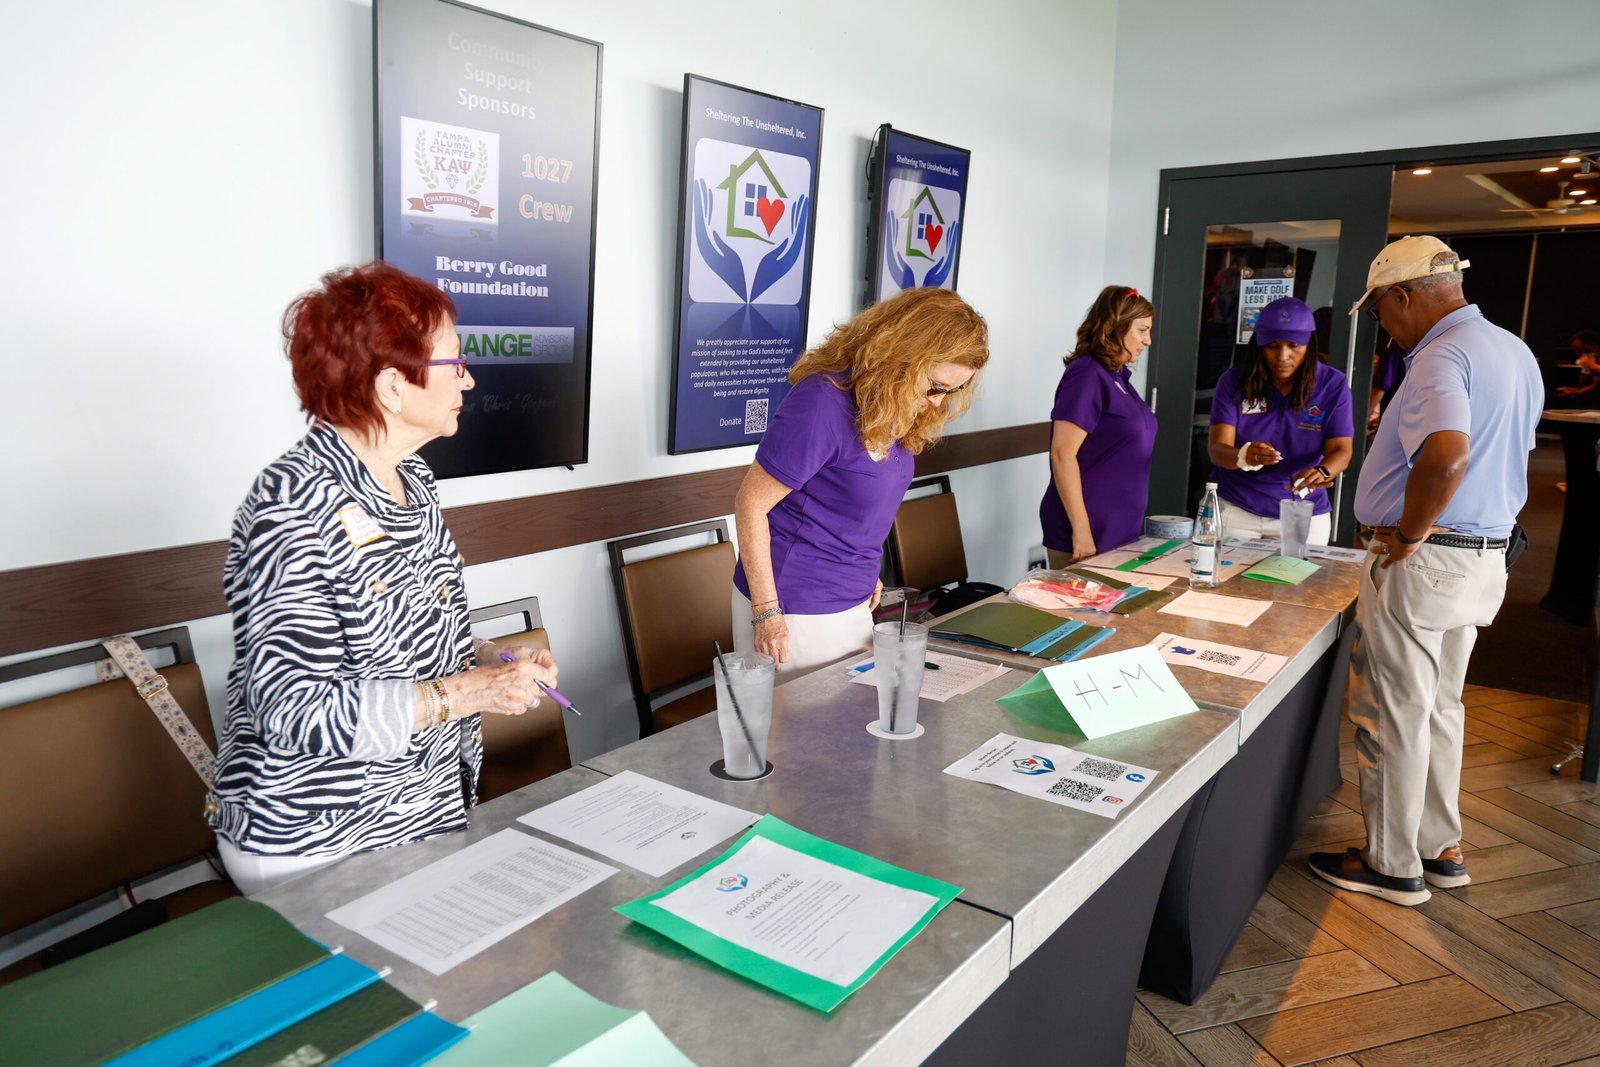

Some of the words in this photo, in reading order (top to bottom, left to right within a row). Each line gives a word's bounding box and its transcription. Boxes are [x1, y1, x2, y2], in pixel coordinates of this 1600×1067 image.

[447, 32, 545, 73] Community
[464, 62, 532, 95] Support
[457, 87, 536, 120] Sponsors
[705, 108, 741, 127] Sheltering
[742, 116, 754, 128] The
[755, 119, 795, 138] Unsheltered,
[796, 128, 807, 139] Inc.
[433, 138, 472, 151] ALUMNI
[435, 131, 470, 143] TAMPA
[429, 146, 476, 159] CHAPTER
[521, 152, 573, 183] 1027
[896, 154, 918, 168] Sheltering
[927, 161, 951, 176] Unsheltered,
[518, 194, 573, 224] Crew
[435, 256, 496, 278] Berry
[499, 260, 548, 278] Good
[437, 278, 549, 297] Foundation
[1245, 286, 1268, 295] MAKE
[1270, 285, 1290, 294] GOLF
[1244, 295, 1264, 303] LESS
[705, 339, 723, 347] greatly
[723, 339, 748, 347] appreciate
[777, 338, 783, 346] of
[711, 349, 717, 357] of
[717, 349, 735, 357] seeking
[729, 359, 751, 367] providing
[690, 371, 719, 379] population,
[719, 417, 742, 427] Donate
[725, 877, 782, 917] PHOTOGRAPHY
[745, 900, 773, 920] MEDIA
[770, 879, 804, 902] RELEASE
